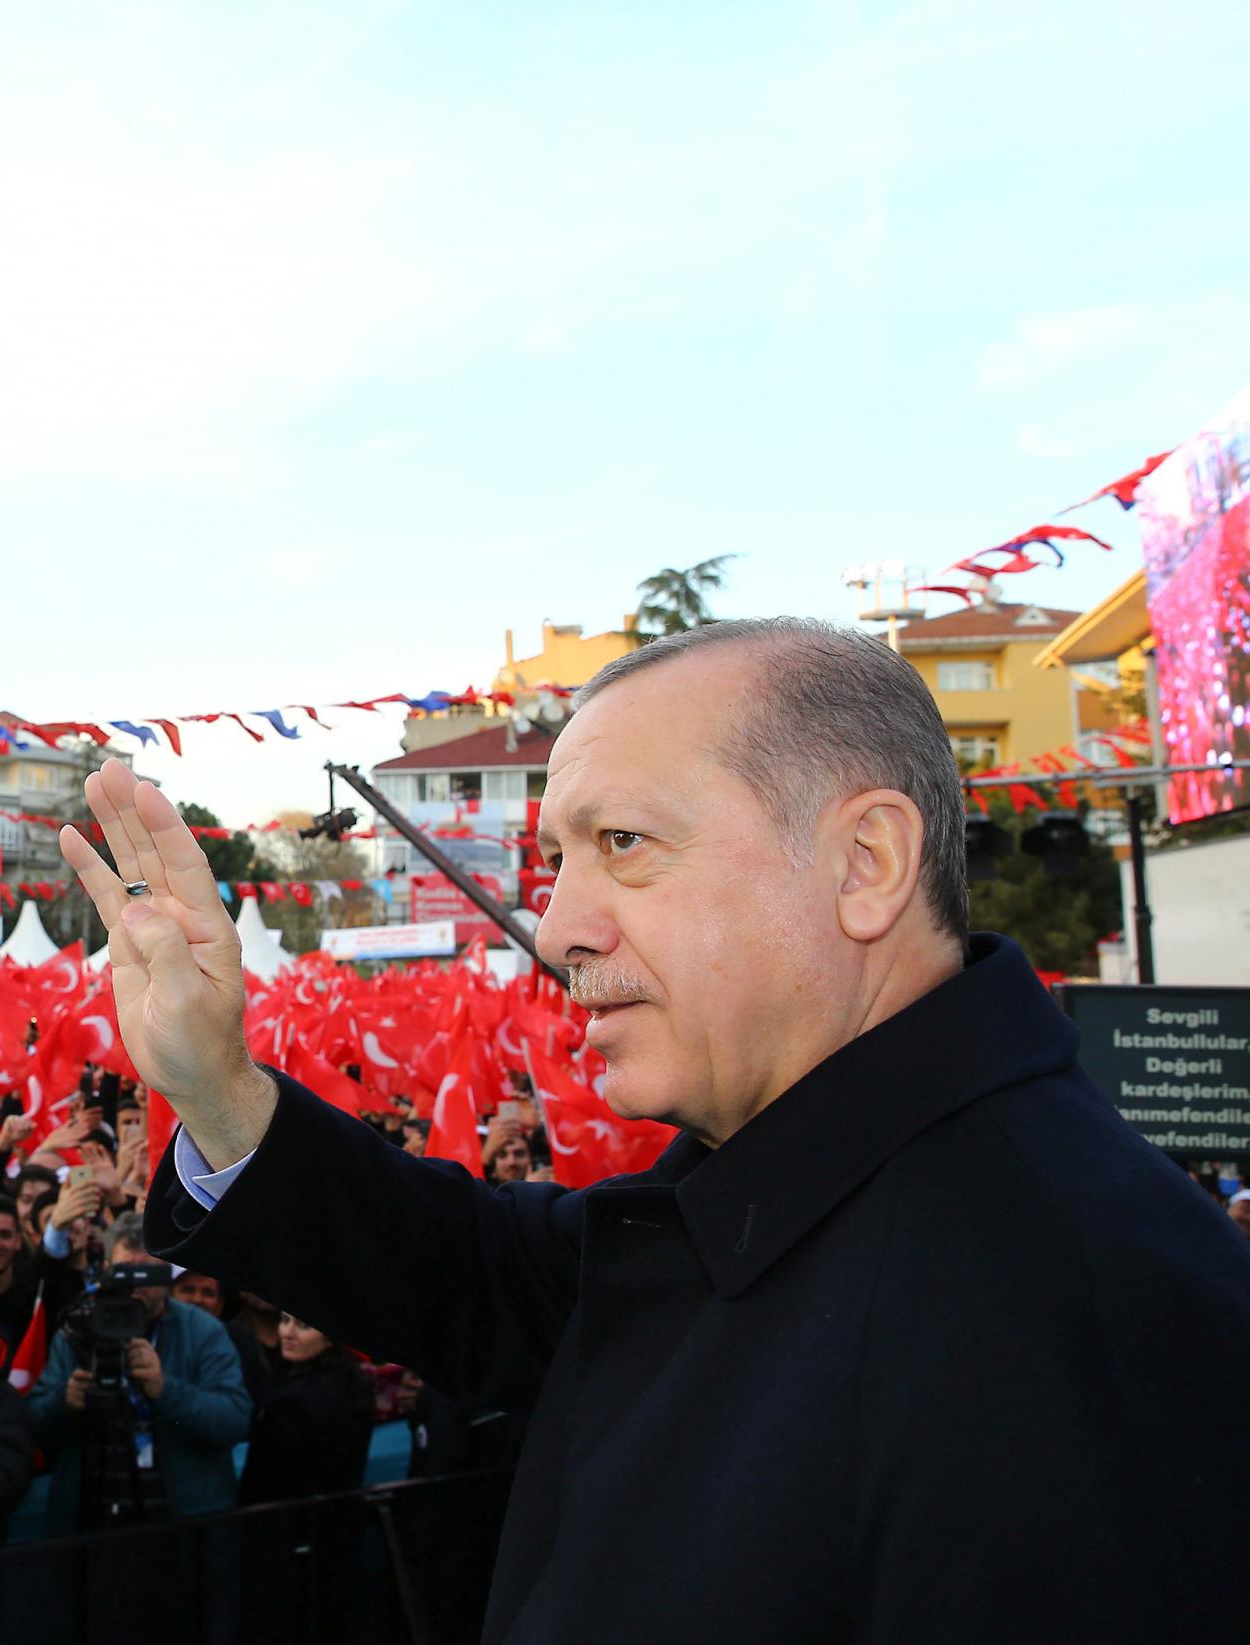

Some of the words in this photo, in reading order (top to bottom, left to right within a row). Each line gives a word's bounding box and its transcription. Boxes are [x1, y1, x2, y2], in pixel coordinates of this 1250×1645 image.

[1147, 1008, 1218, 1028] Sevgili
[1146, 1057, 1222, 1077] Değerli
[1120, 1080, 1250, 1102] kardeşlerim
[1113, 1104, 1250, 1124] anımefendile
